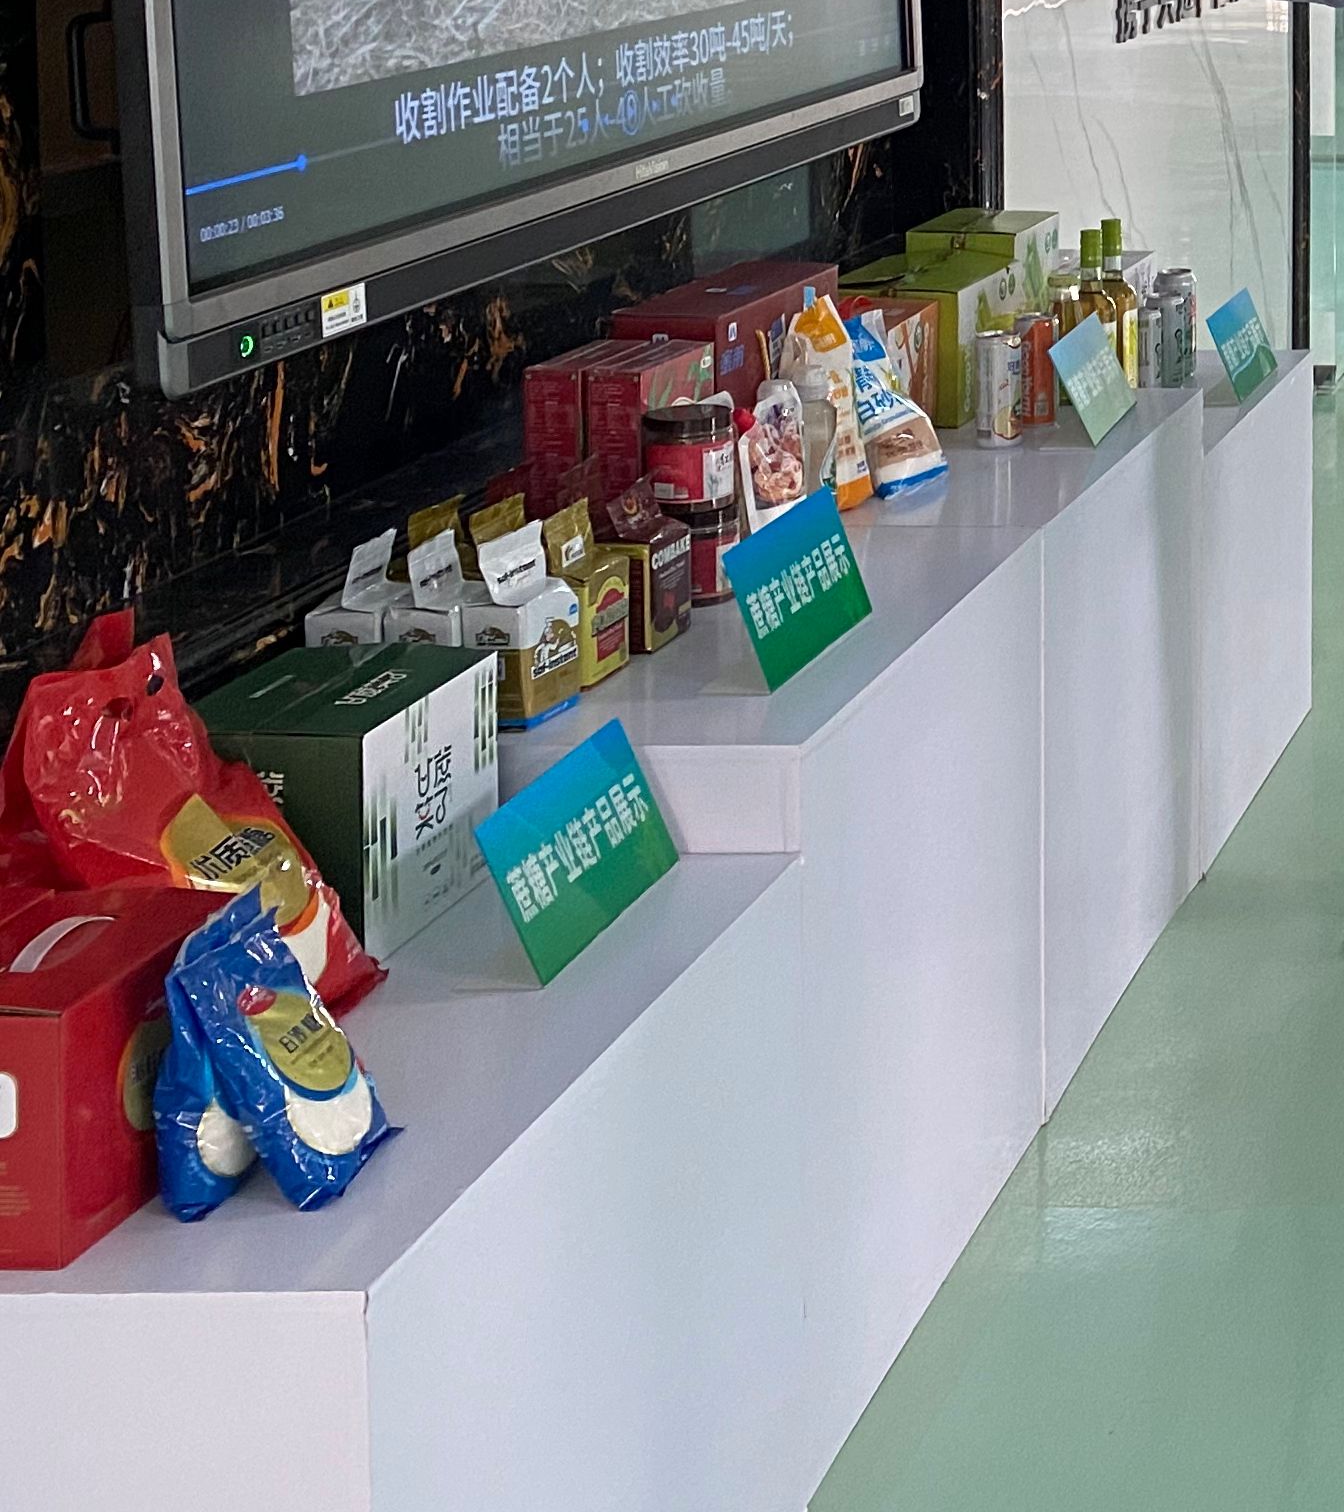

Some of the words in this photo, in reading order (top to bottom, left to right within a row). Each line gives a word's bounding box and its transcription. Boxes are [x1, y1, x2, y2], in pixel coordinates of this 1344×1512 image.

[651, 533, 691, 571] COMBAKE
[746, 532, 846, 634] 蔗糖产业链产品展示
[532, 647, 578, 678] saf-instant
[506, 772, 649, 923] 蔗糖产业链产品展示
